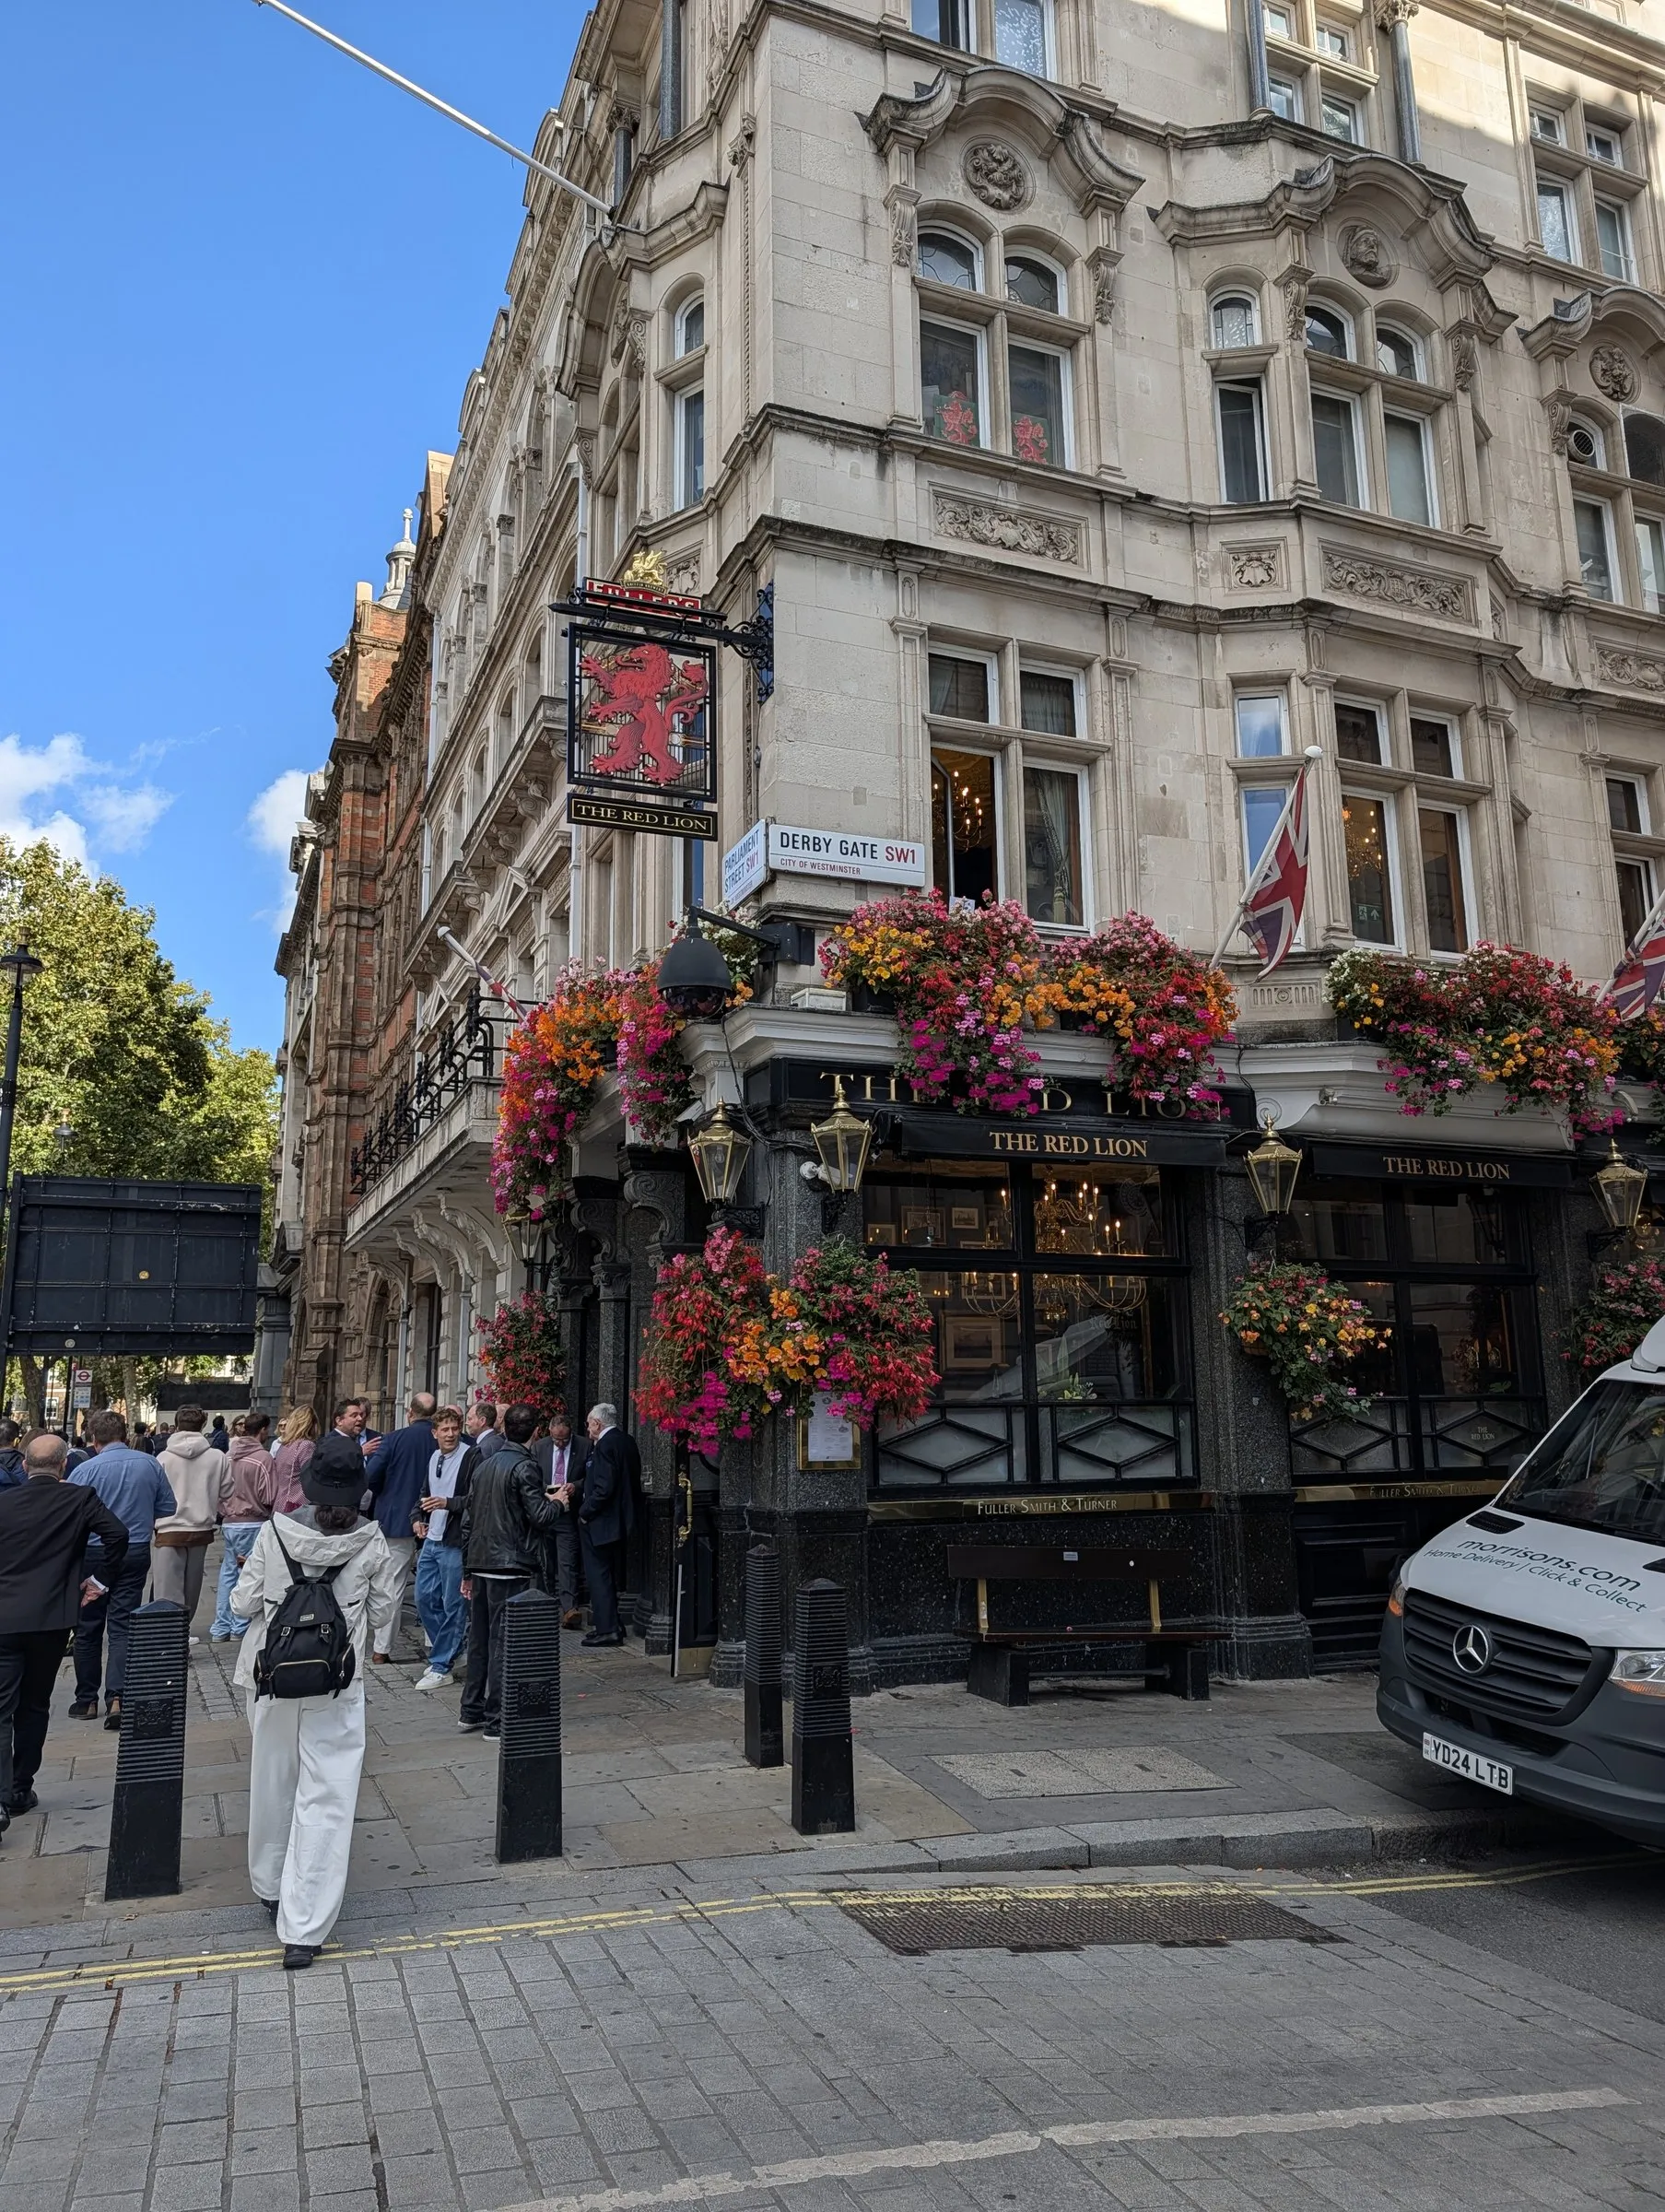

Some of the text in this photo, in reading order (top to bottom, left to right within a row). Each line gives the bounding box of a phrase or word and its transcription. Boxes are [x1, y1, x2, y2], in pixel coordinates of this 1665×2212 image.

[577, 804, 708, 831] THE RED LION
[724, 829, 759, 875] PARLIAMENT
[780, 831, 917, 865] DERBY GATE SW1
[724, 849, 759, 893] STREET SW1
[780, 857, 862, 876] CITY OF WESTMINSTER
[990, 1131, 1149, 1158] THE RED LION
[1383, 1156, 1511, 1180] THE RED LION
[1061, 1498, 1073, 1512] &
[1424, 1548, 1462, 1560] Home
[1462, 1552, 1519, 1573] Delivery
[1528, 1565, 1567, 1583] Click
[1567, 1576, 1581, 1588] &
[1584, 1583, 1648, 1614] Collect
[1457, 1537, 1642, 1592] morrisons.com
[1433, 1739, 1508, 1789] YD24 LTB
